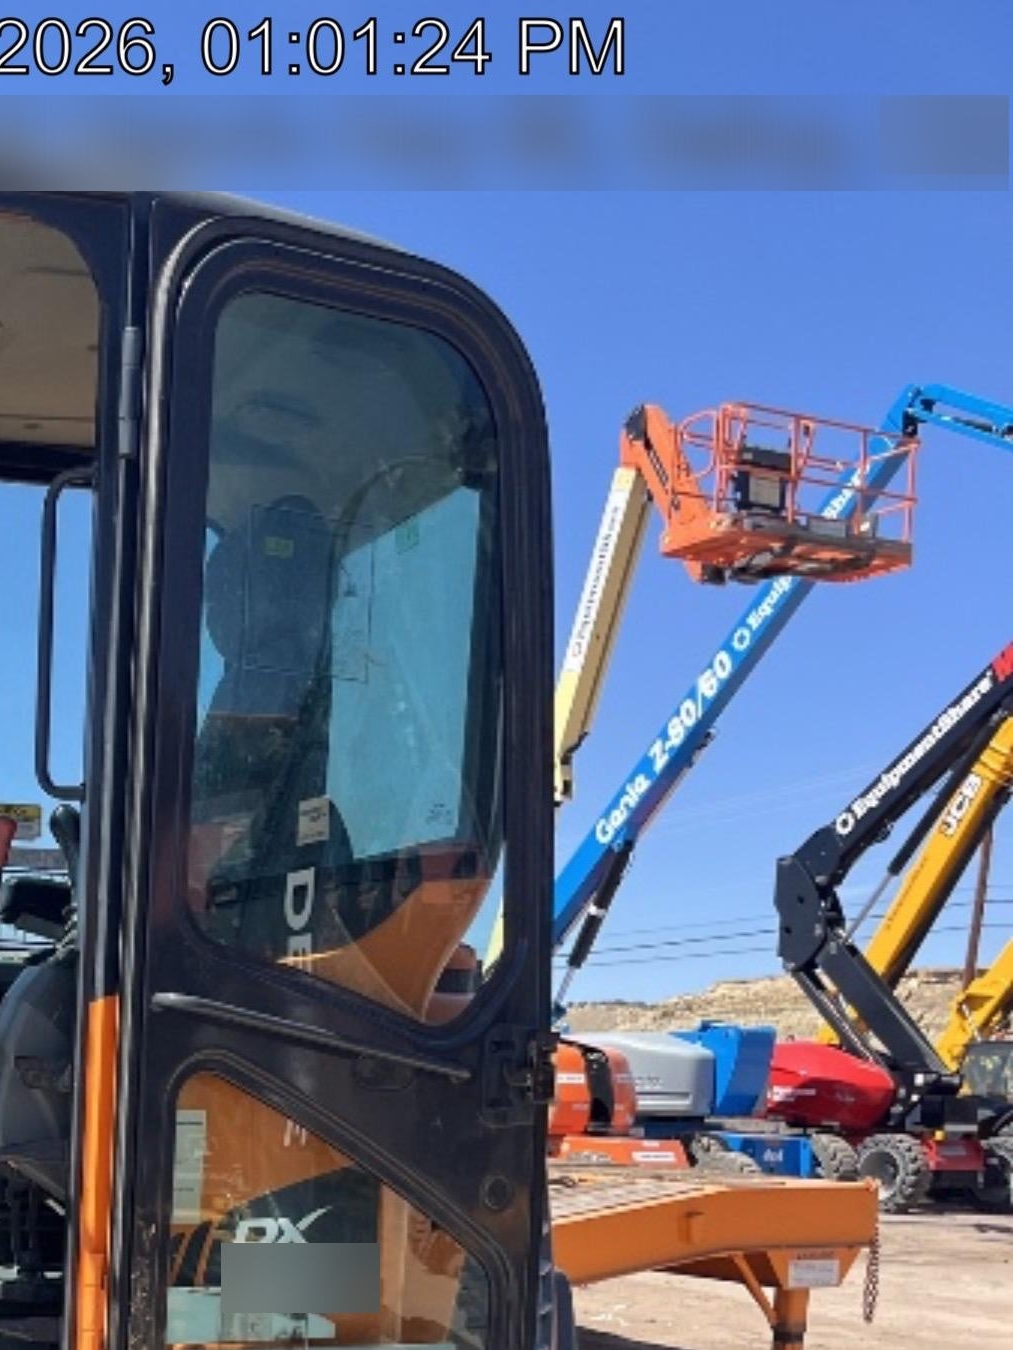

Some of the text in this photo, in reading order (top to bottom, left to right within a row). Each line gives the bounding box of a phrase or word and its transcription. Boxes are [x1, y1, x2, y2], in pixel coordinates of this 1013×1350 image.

[595, 650, 732, 844] Genie Z-80/60
[851, 674, 992, 819] EquipmentShare
[941, 773, 982, 836] JCB
